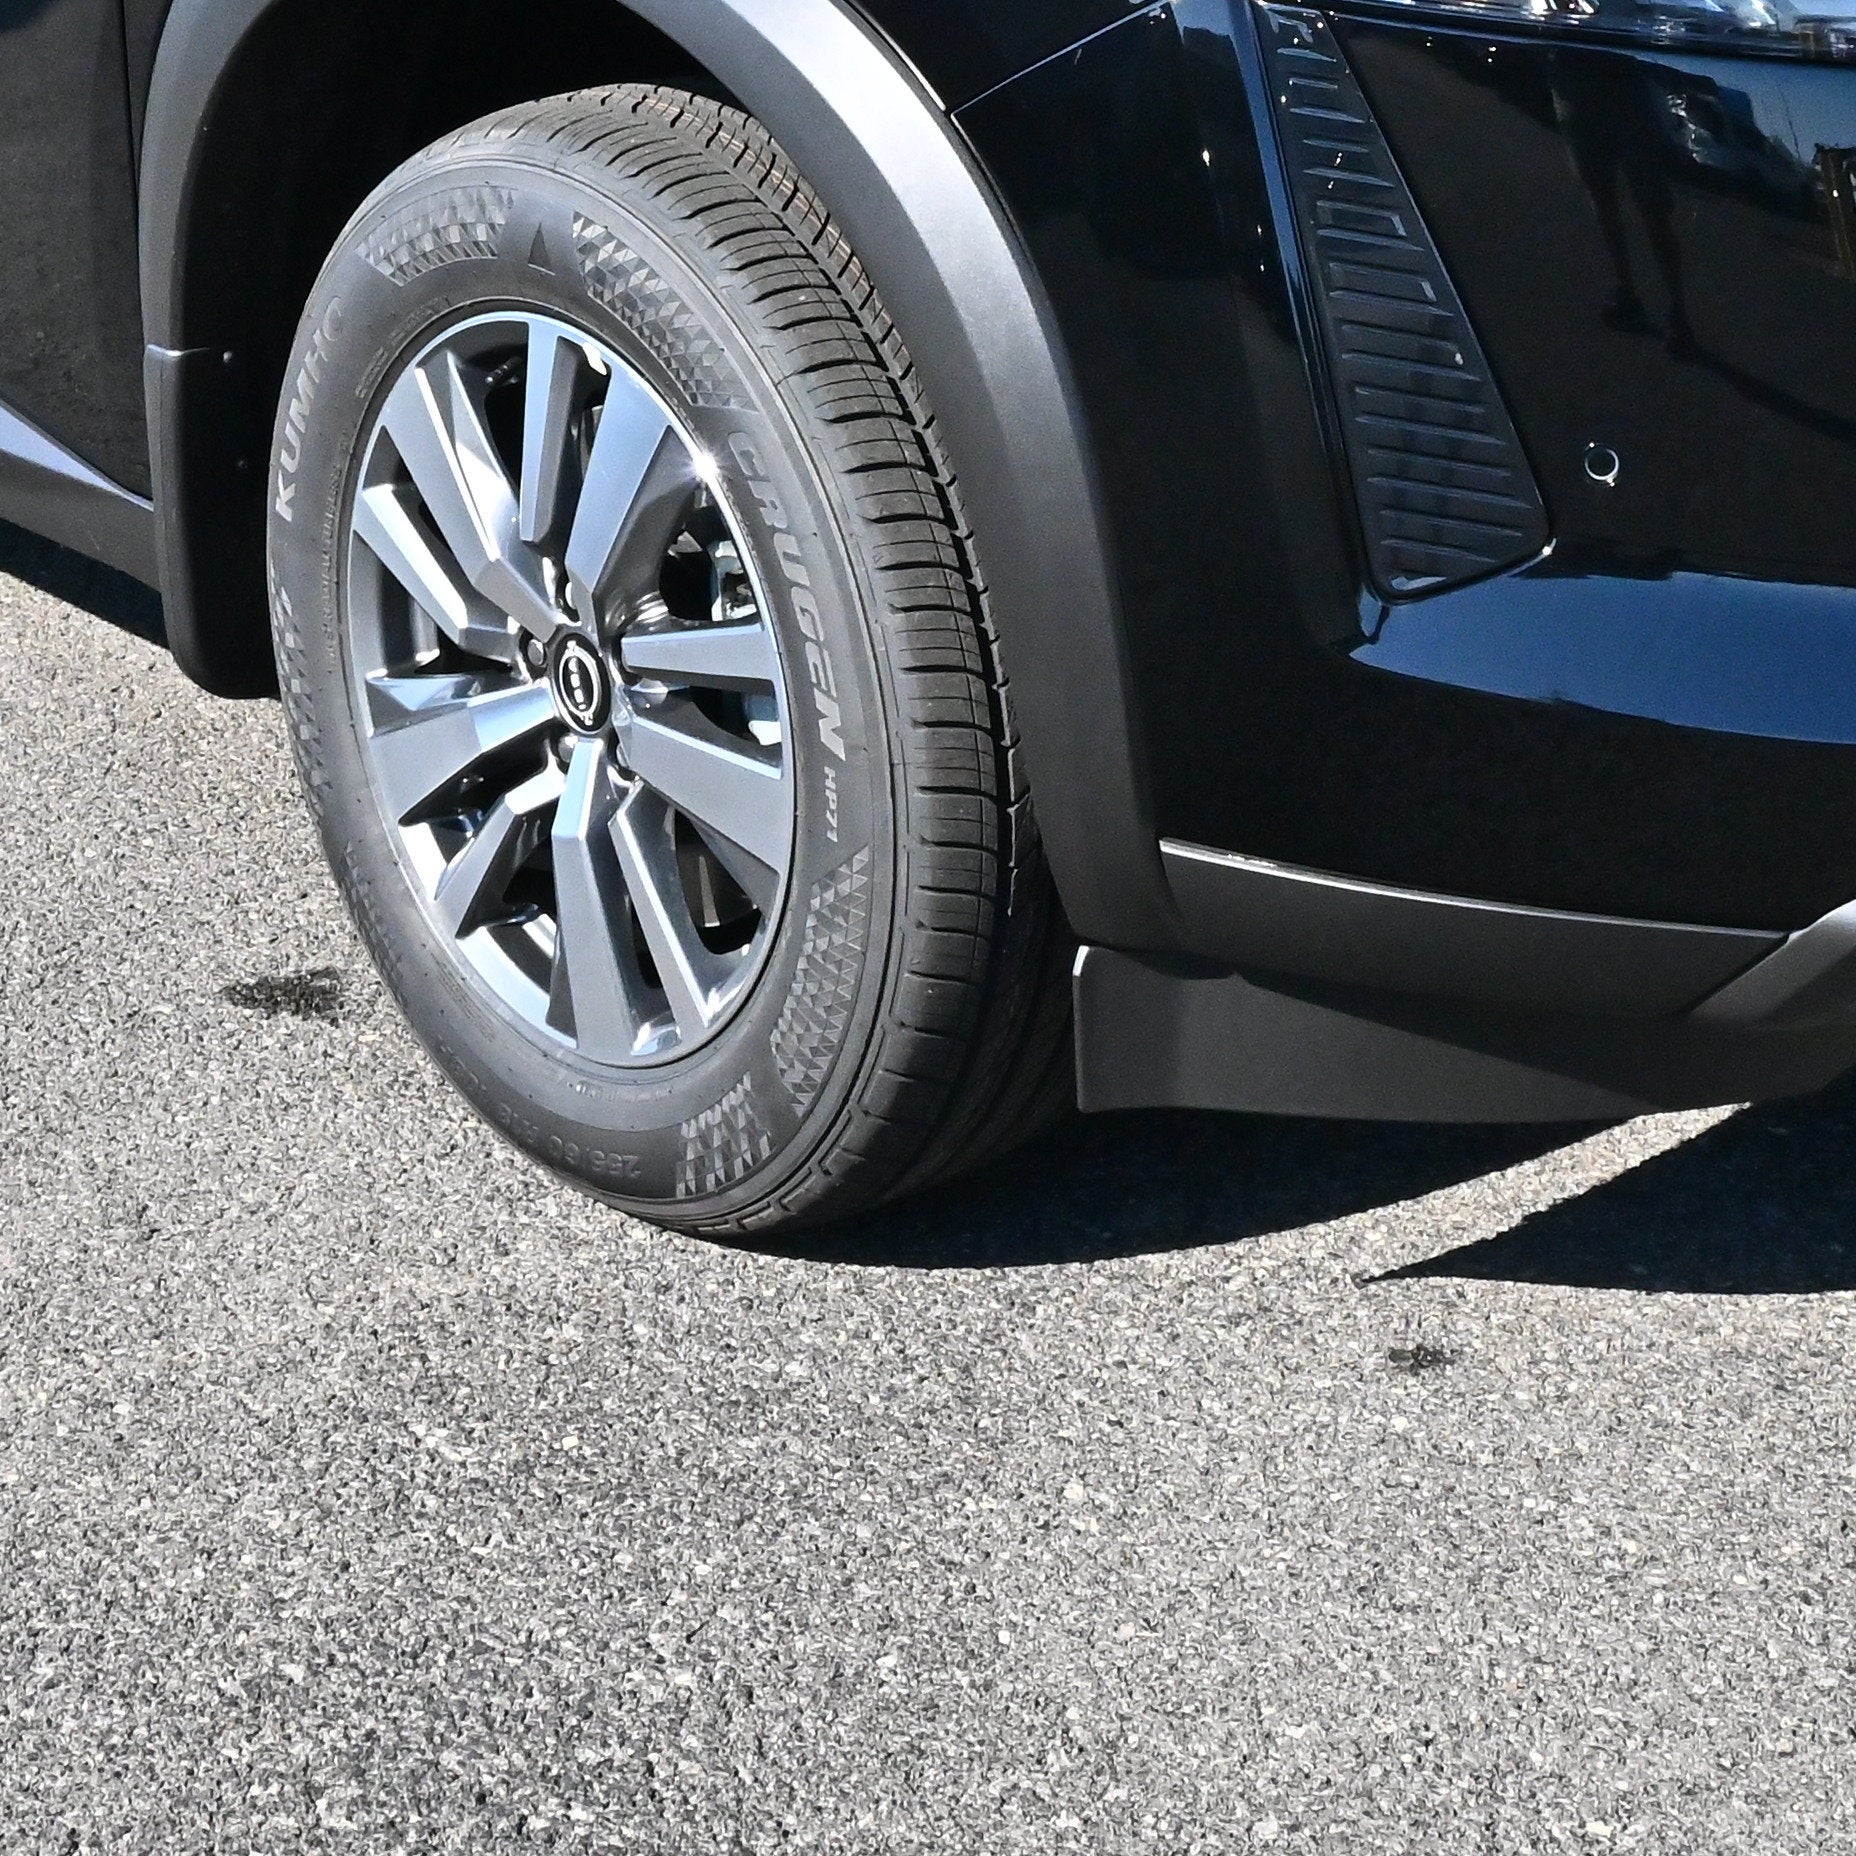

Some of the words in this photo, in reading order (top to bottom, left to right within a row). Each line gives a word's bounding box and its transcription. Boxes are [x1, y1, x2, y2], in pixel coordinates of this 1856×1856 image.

[275, 296, 344, 523] KUMHO
[727, 431, 847, 763] CRUGEN
[823, 765, 838, 844] HP71
